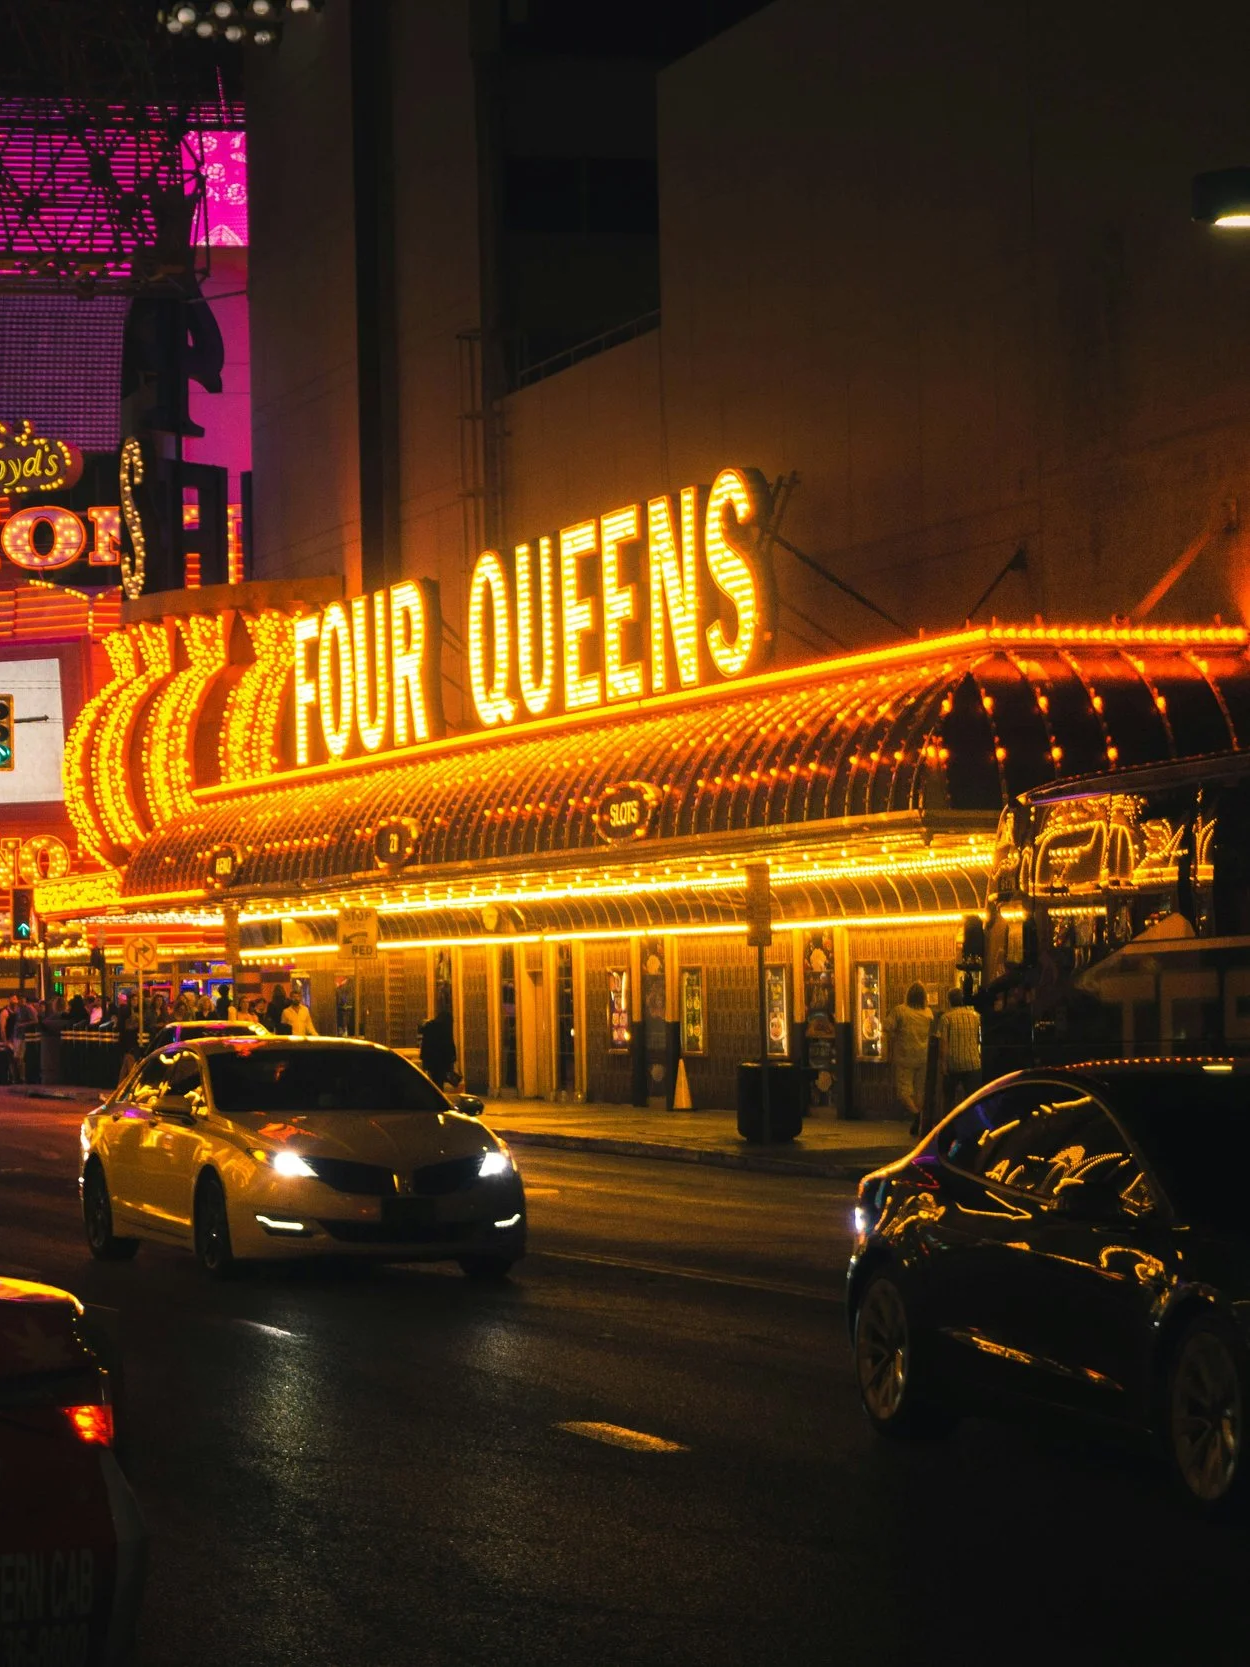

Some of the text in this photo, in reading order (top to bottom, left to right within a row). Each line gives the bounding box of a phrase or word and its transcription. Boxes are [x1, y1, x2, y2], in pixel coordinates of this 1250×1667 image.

[294, 467, 760, 767] FOUR QUEENS
[610, 800, 639, 827] SLOTS
[344, 911, 372, 921] STOP
[351, 945, 372, 955] RED
[52, 1548, 95, 1618] CAB
